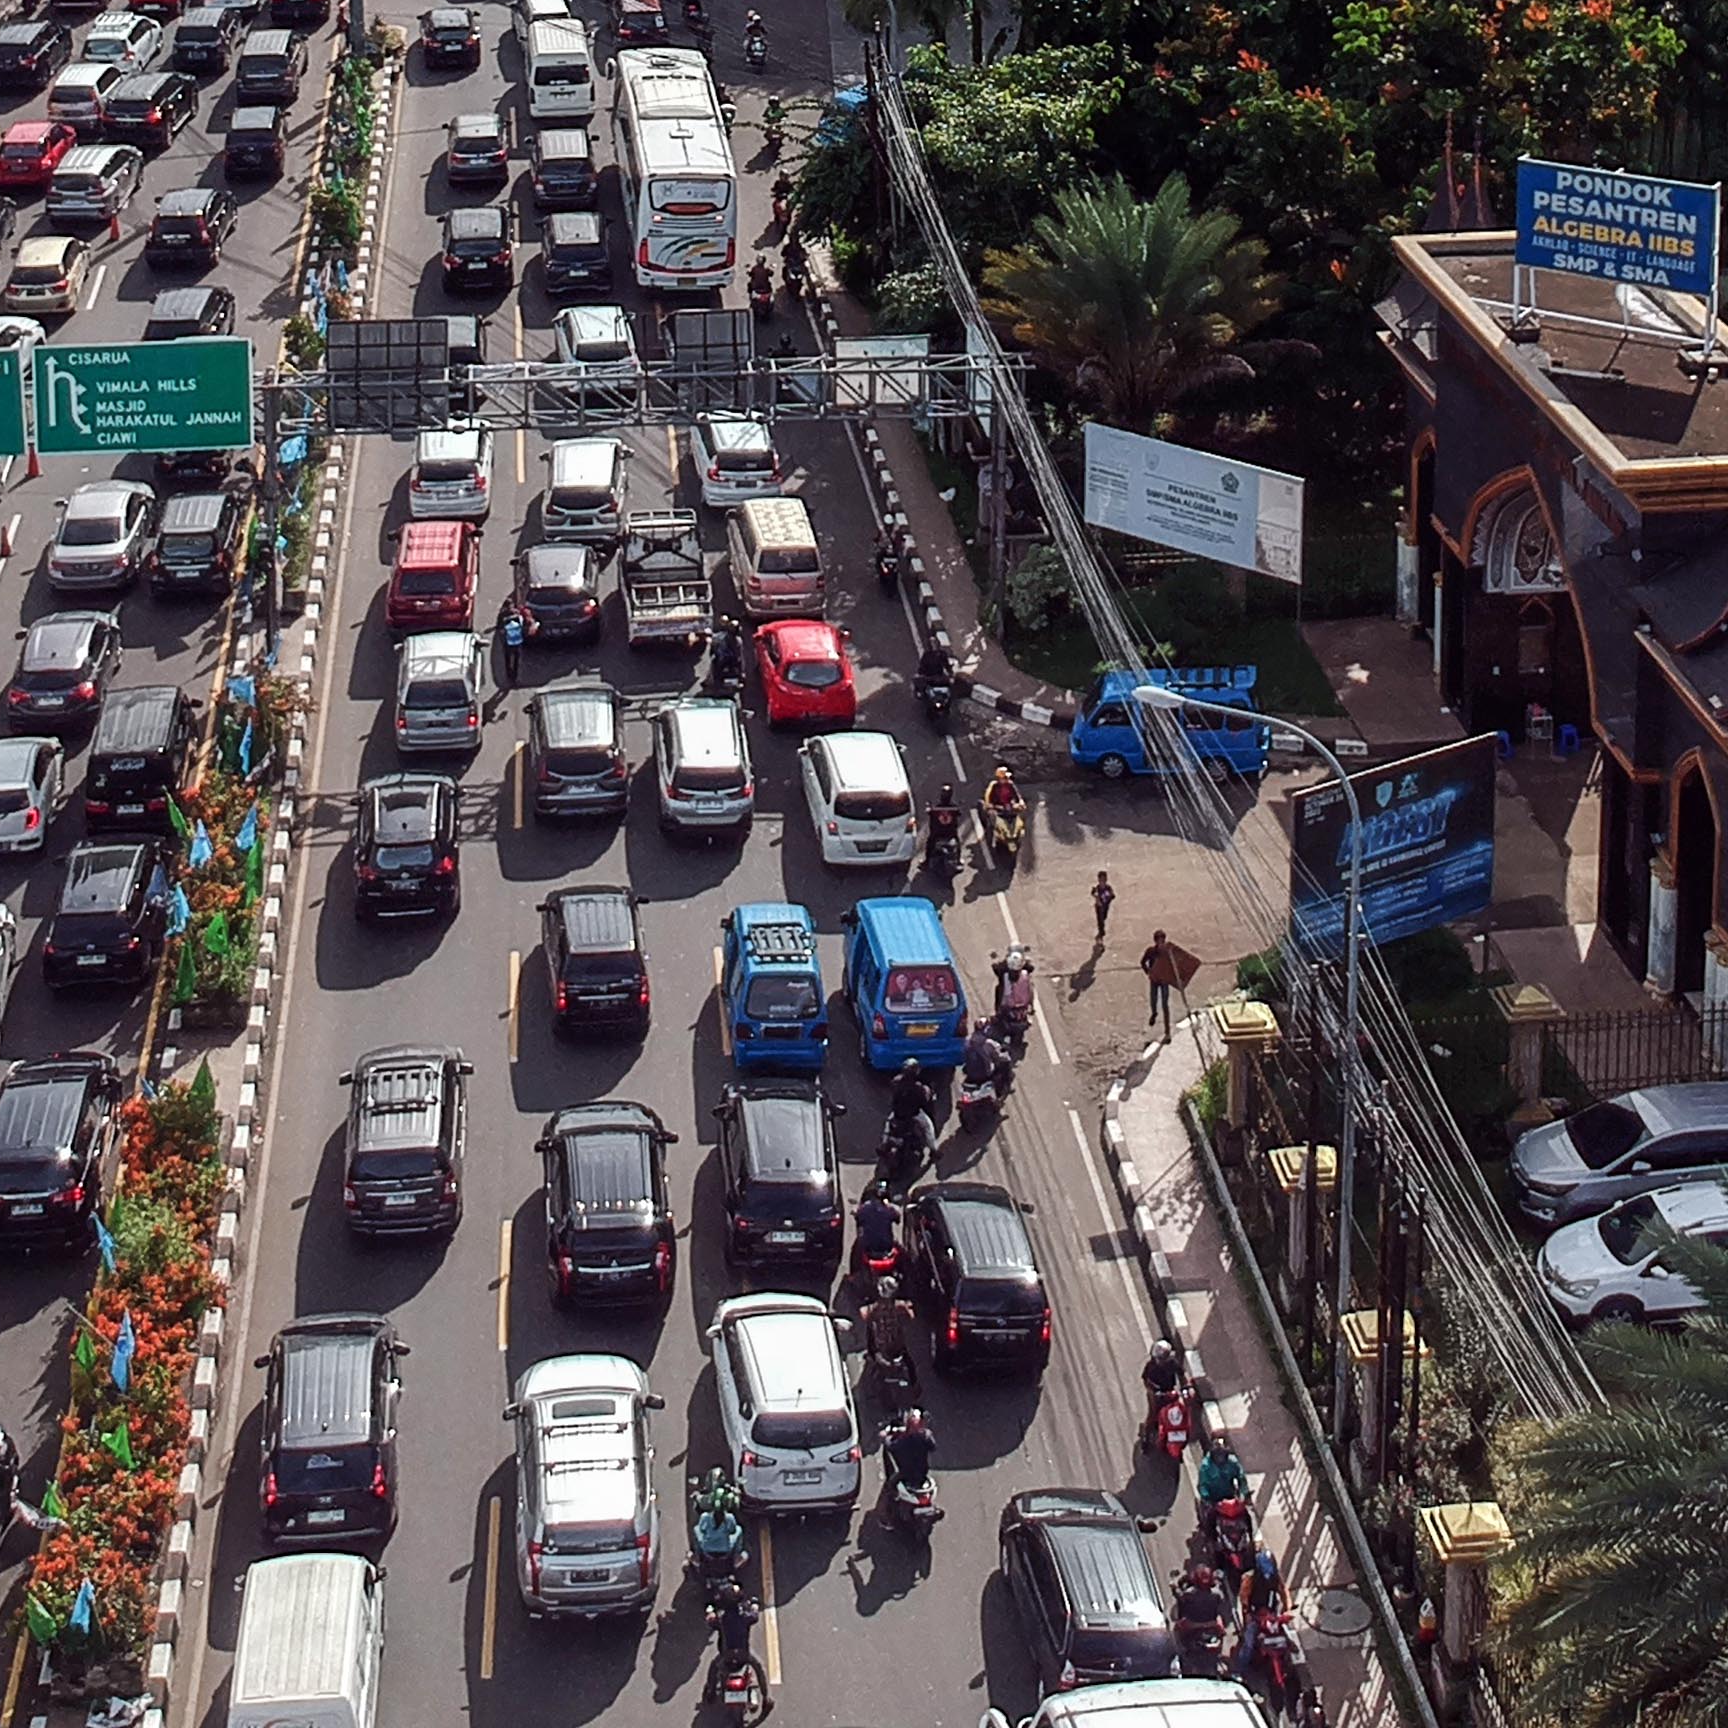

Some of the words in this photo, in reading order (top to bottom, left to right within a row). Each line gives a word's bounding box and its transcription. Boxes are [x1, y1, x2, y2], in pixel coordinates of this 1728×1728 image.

[1557, 171, 1672, 207] PONDOK
[1533, 190, 1697, 235] PESANTREN
[1533, 215, 1643, 248] ALGEBRA
[1649, 233, 1695, 257] IIBS
[1578, 242, 1617, 259] SCIENCE
[1626, 251, 1636, 262] IT
[1646, 253, 1696, 274] LANGUAGE
[1553, 253, 1599, 273] SMP
[1603, 261, 1617, 277] &
[1621, 264, 1670, 285] SMA
[69, 352, 131, 366] CISARUA
[96, 380, 149, 393] VIMALA
[157, 378, 197, 391] HILLS
[96, 400, 146, 413] MASJID
[96, 413, 177, 428] HARAKATUL
[186, 411, 242, 426] JANNAH
[97, 432, 137, 444] CIAWI
[1168, 484, 1216, 504] PESANTREN
